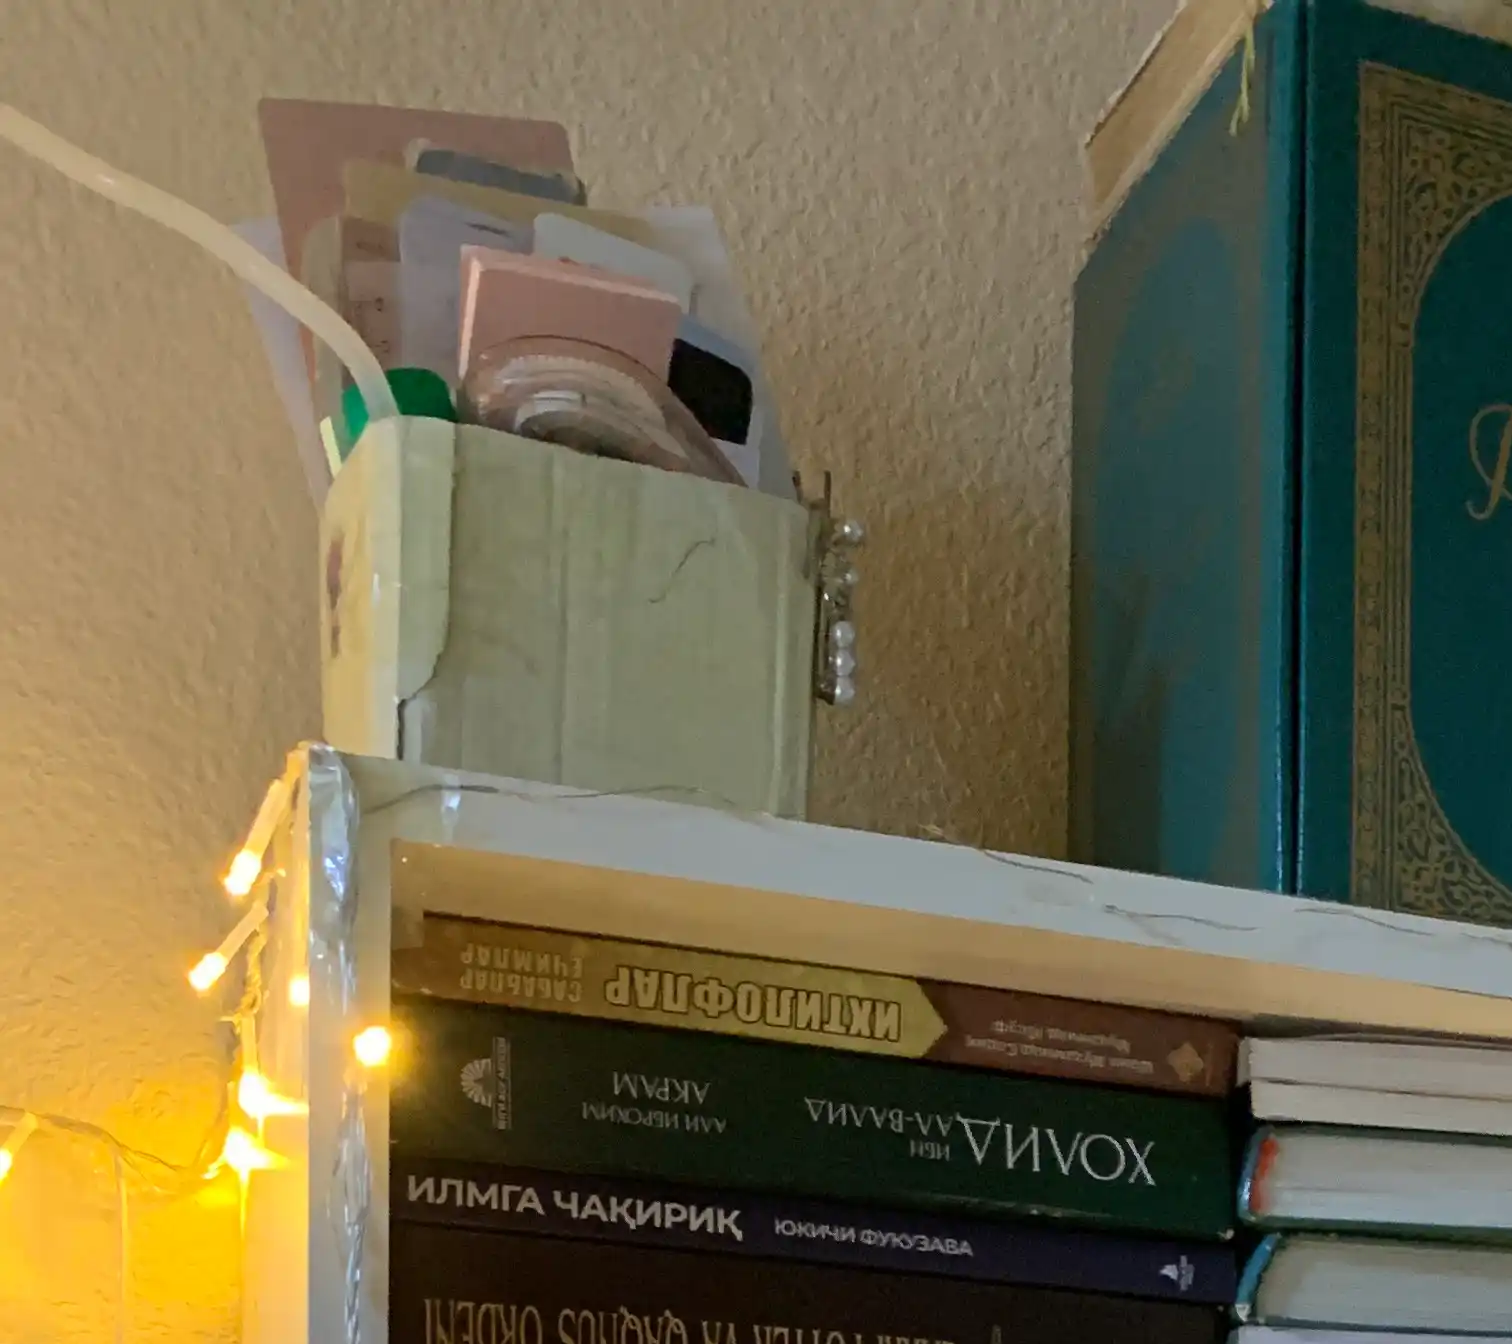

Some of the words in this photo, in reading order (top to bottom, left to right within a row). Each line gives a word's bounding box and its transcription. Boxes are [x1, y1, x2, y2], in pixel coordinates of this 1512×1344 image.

[604, 966, 902, 1045] ИХТИЛОФЛАР
[612, 1071, 710, 1103] АКРАМ
[804, 1097, 954, 1136] АЛ-ВАЛИД
[955, 1112, 1156, 1186] ХОЛИД
[406, 1175, 547, 1218] ИЛМГА
[553, 1190, 743, 1242] ЧАҚИРИҚ
